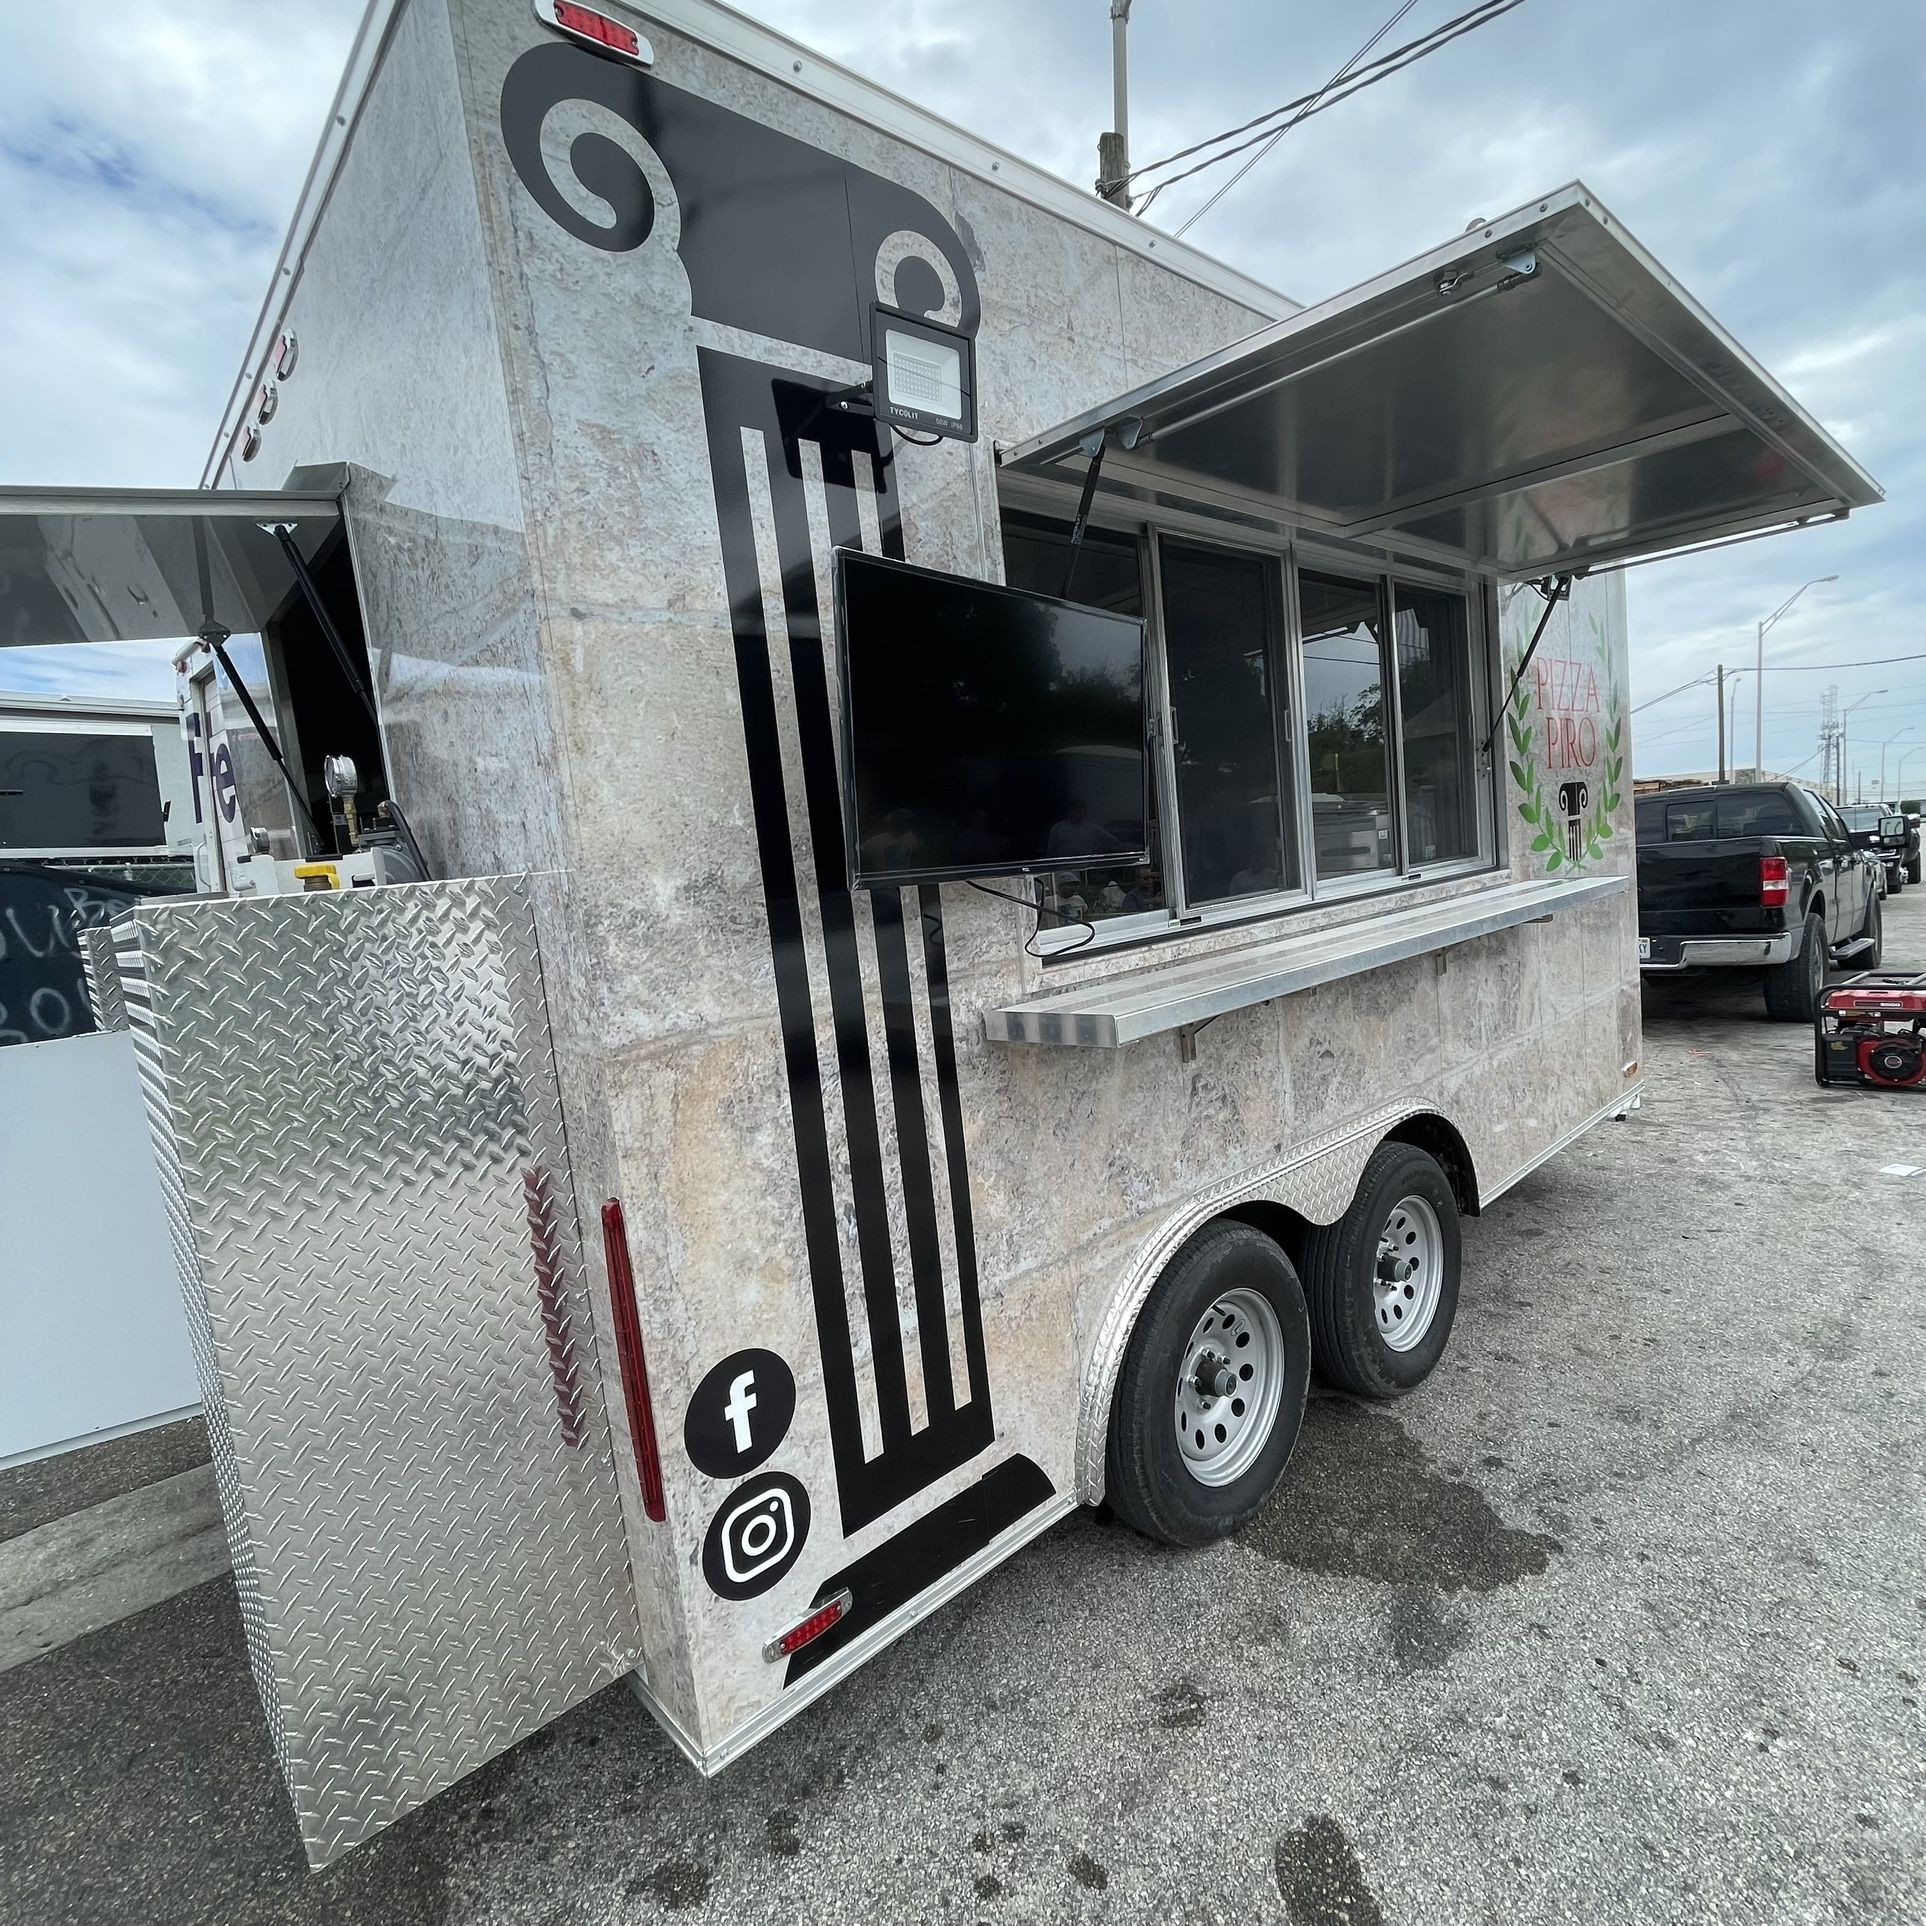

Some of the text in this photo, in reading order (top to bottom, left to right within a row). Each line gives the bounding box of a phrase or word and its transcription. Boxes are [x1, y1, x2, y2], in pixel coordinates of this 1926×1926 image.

[889, 406, 919, 420] TYCOLIT
[1535, 655, 1601, 714] PIZZA
[1546, 716, 1597, 770] PIRO
